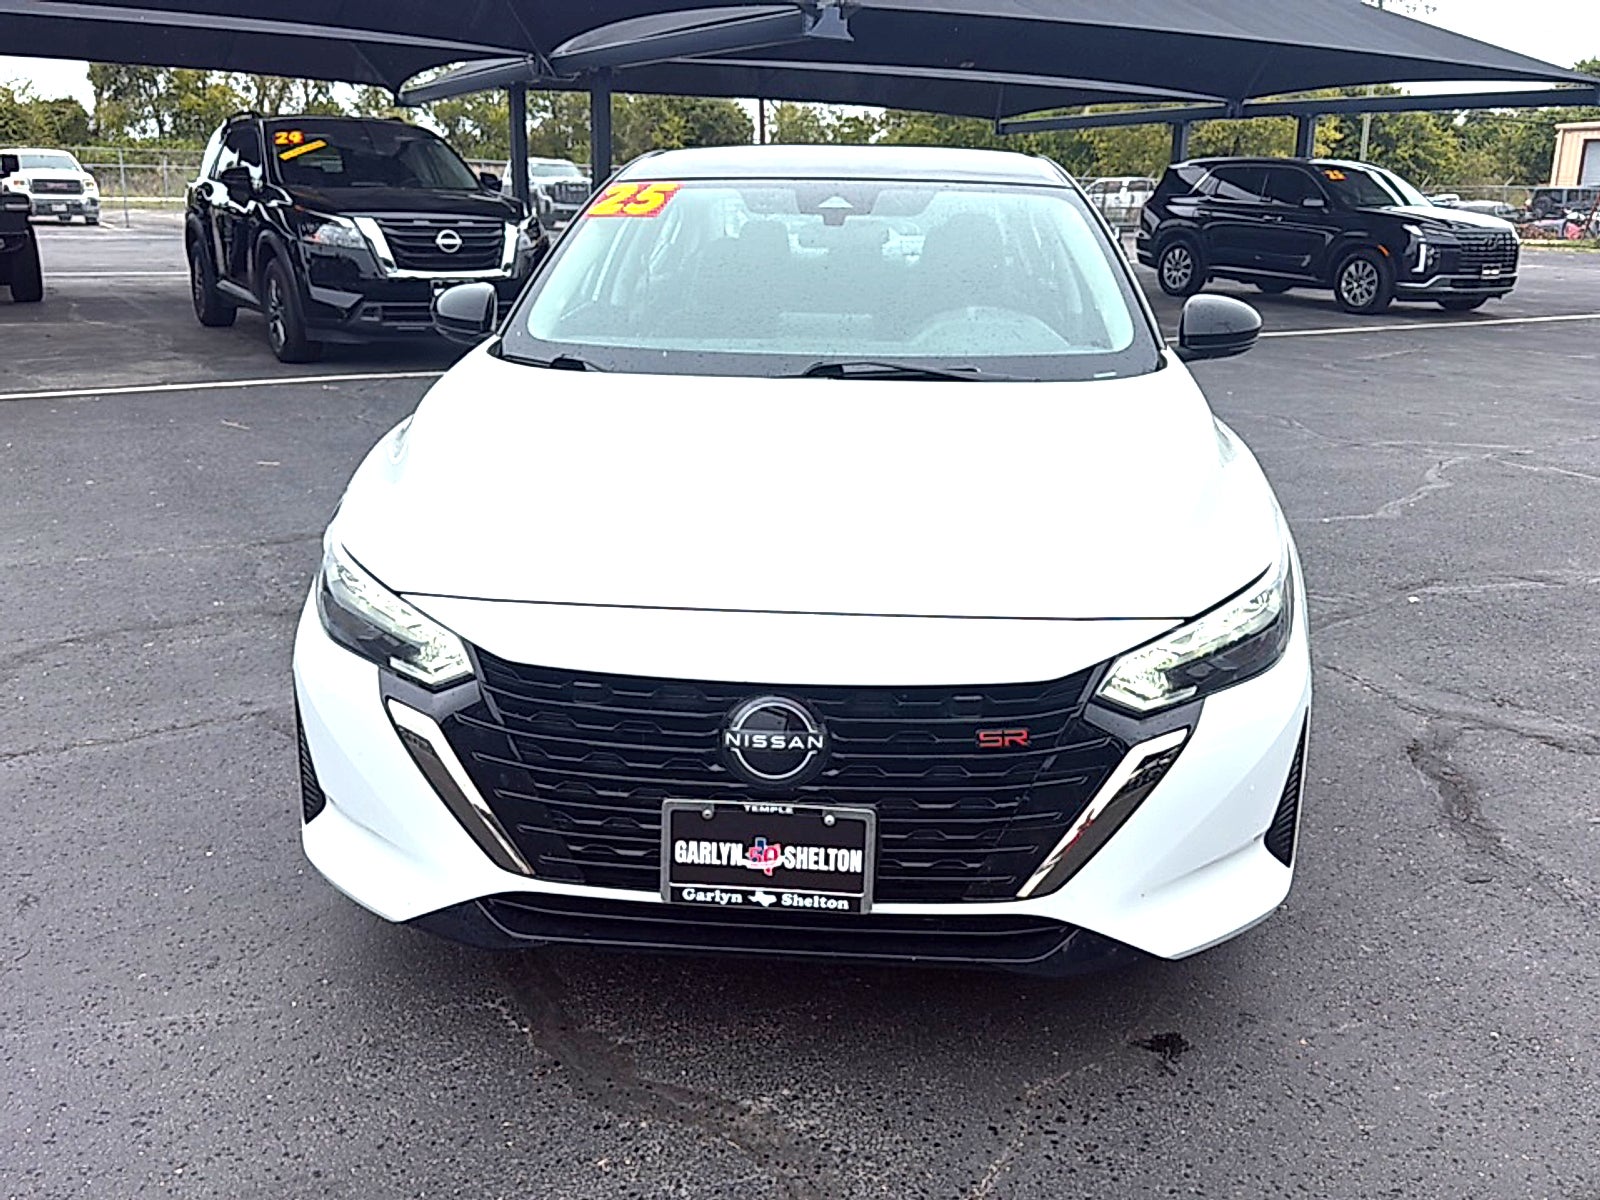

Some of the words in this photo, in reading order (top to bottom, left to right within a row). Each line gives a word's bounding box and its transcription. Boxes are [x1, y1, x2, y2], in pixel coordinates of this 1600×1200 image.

[587, 183, 679, 215] 25
[725, 732, 824, 749] NISSAN
[978, 729, 1029, 748] SR
[744, 804, 794, 815] TEMPLE
[674, 840, 744, 866] GARLYN
[784, 845, 862, 873] SHELTON
[682, 888, 743, 905] Garlyn
[781, 894, 850, 910] Shelton
